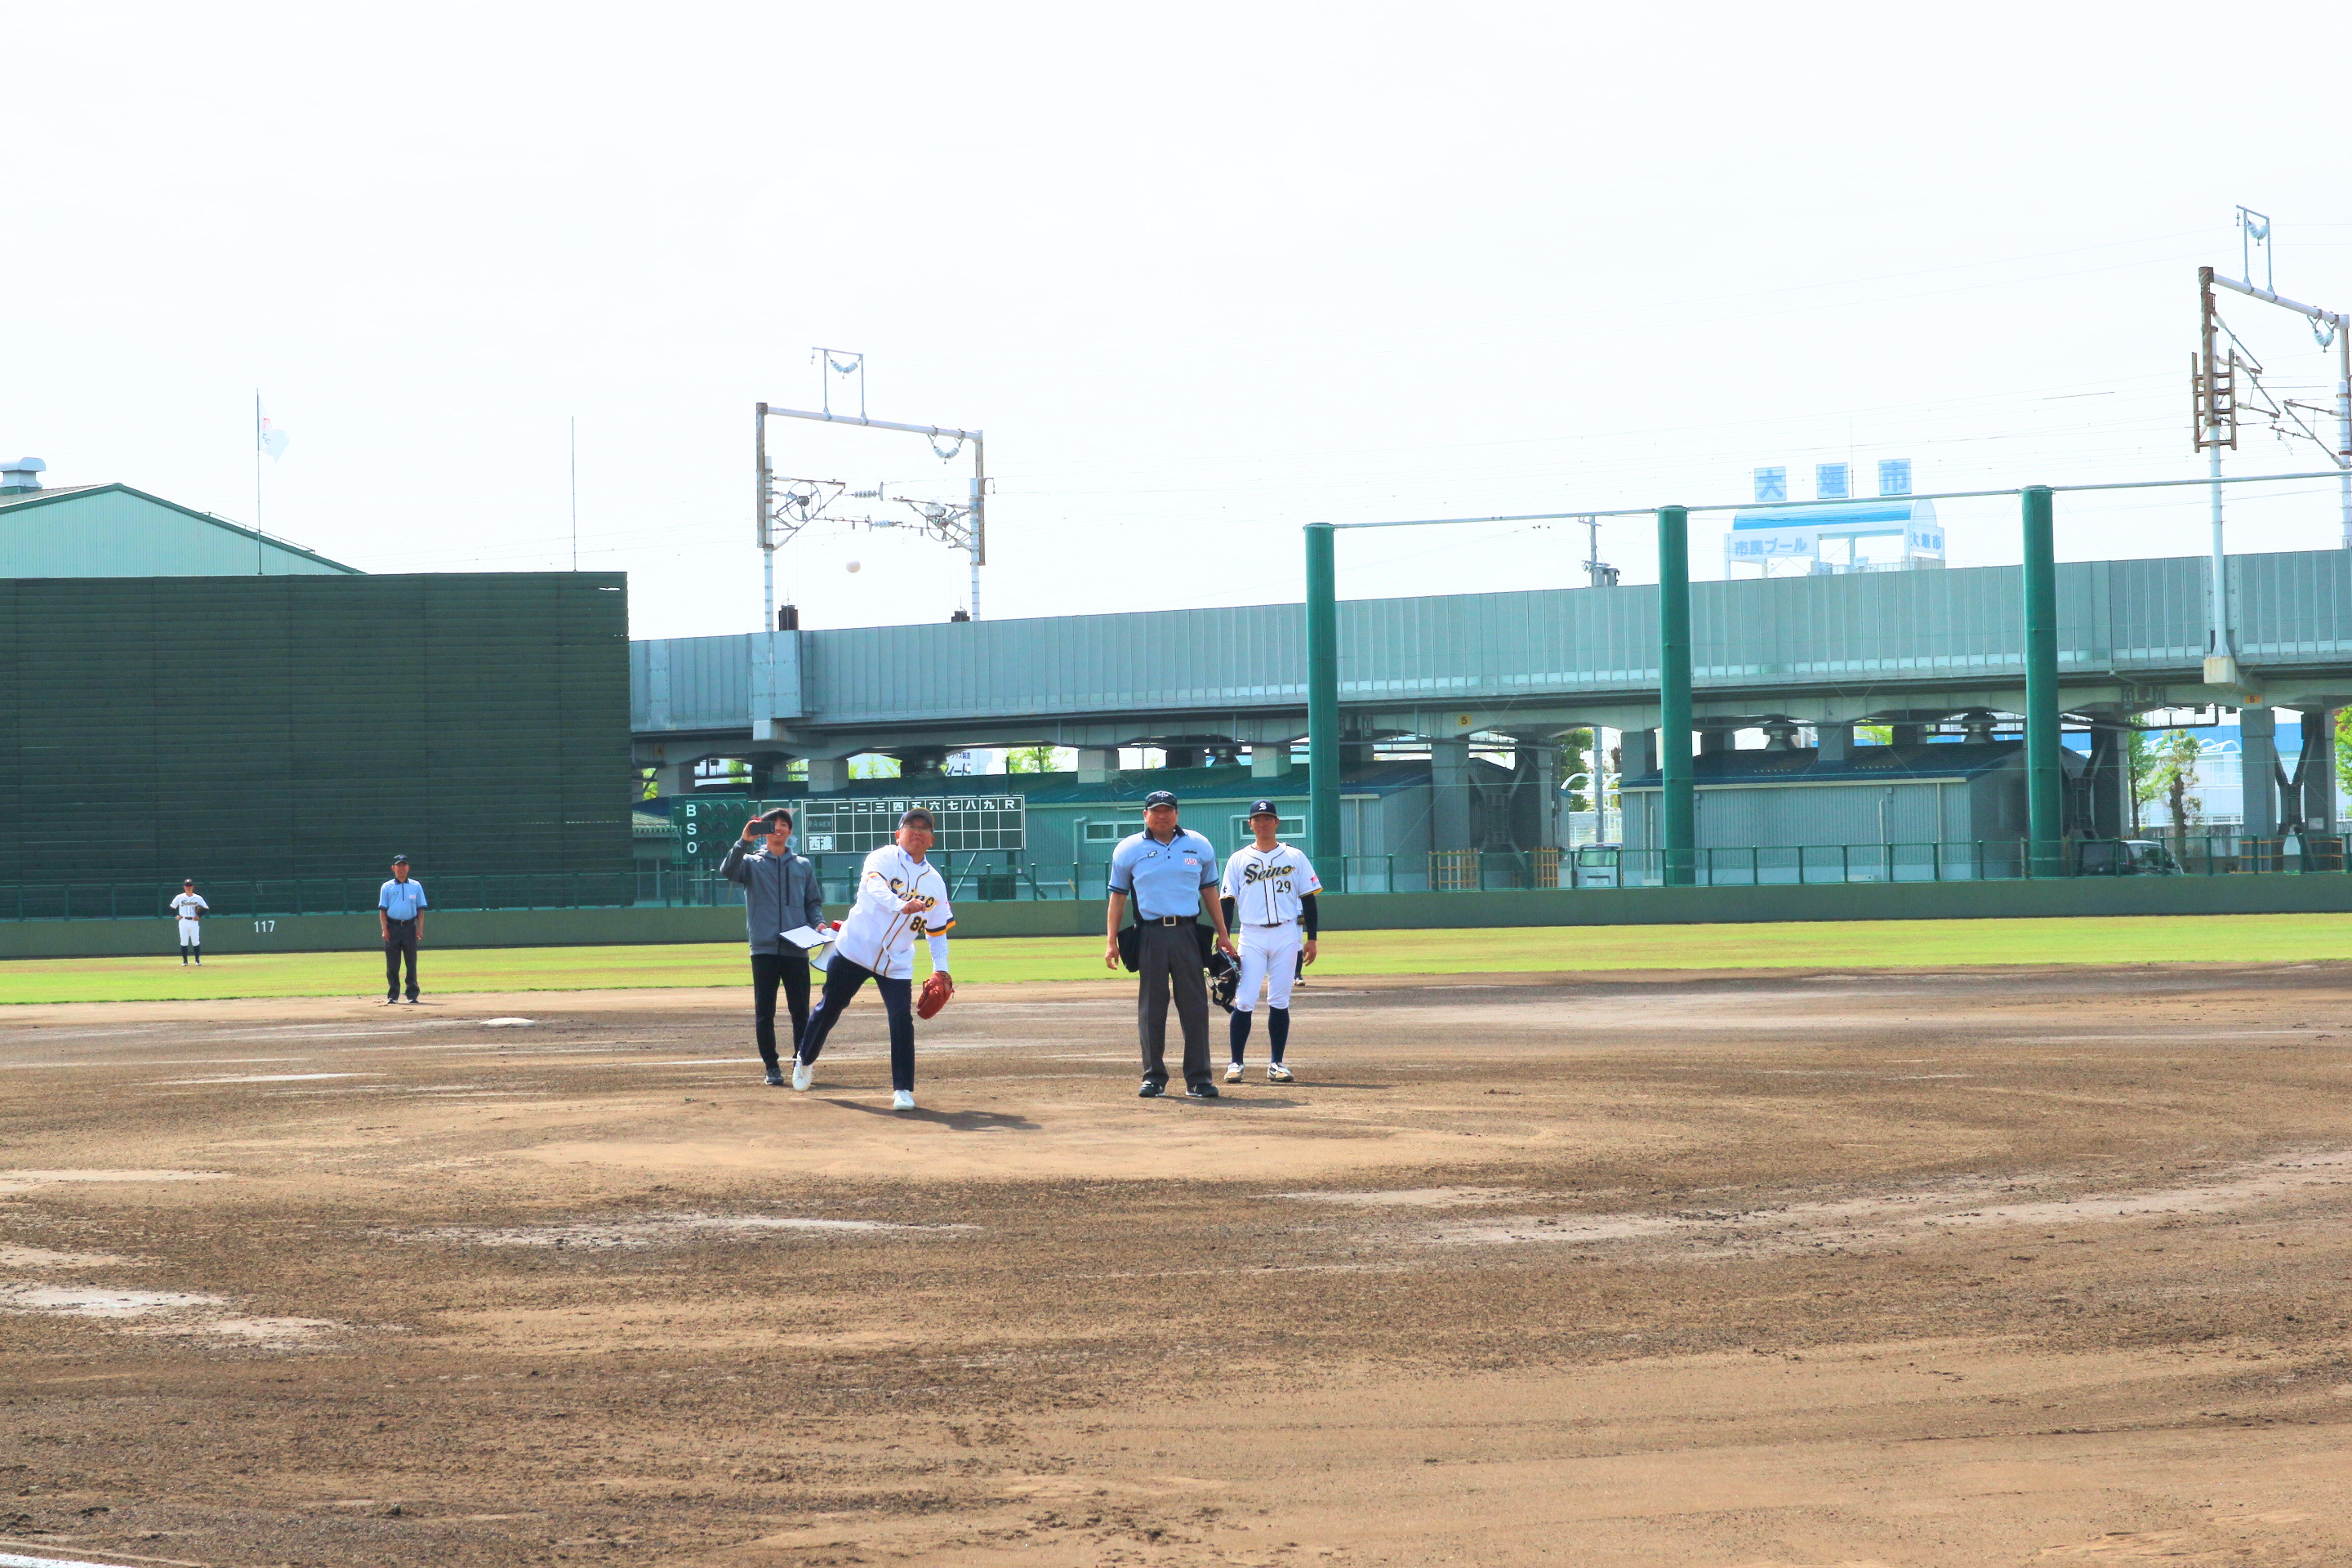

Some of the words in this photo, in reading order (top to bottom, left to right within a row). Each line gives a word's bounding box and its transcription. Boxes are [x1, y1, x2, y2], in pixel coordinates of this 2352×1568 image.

[1462, 716, 1468, 724] 5
[686, 804, 697, 817] B
[857, 803, 867, 812] 二
[875, 802, 886, 812] 三
[893, 801, 904, 812] 四
[929, 800, 940, 811] 六
[947, 801, 959, 811] 七
[965, 800, 977, 810] 八
[983, 800, 995, 810] 九
[1004, 800, 1015, 809] R
[1258, 801, 1267, 811] S
[686, 822, 697, 835] S
[687, 841, 697, 853] O
[1244, 863, 1296, 886] Seino
[1276, 880, 1291, 893] 29
[254, 920, 275, 933] 117
